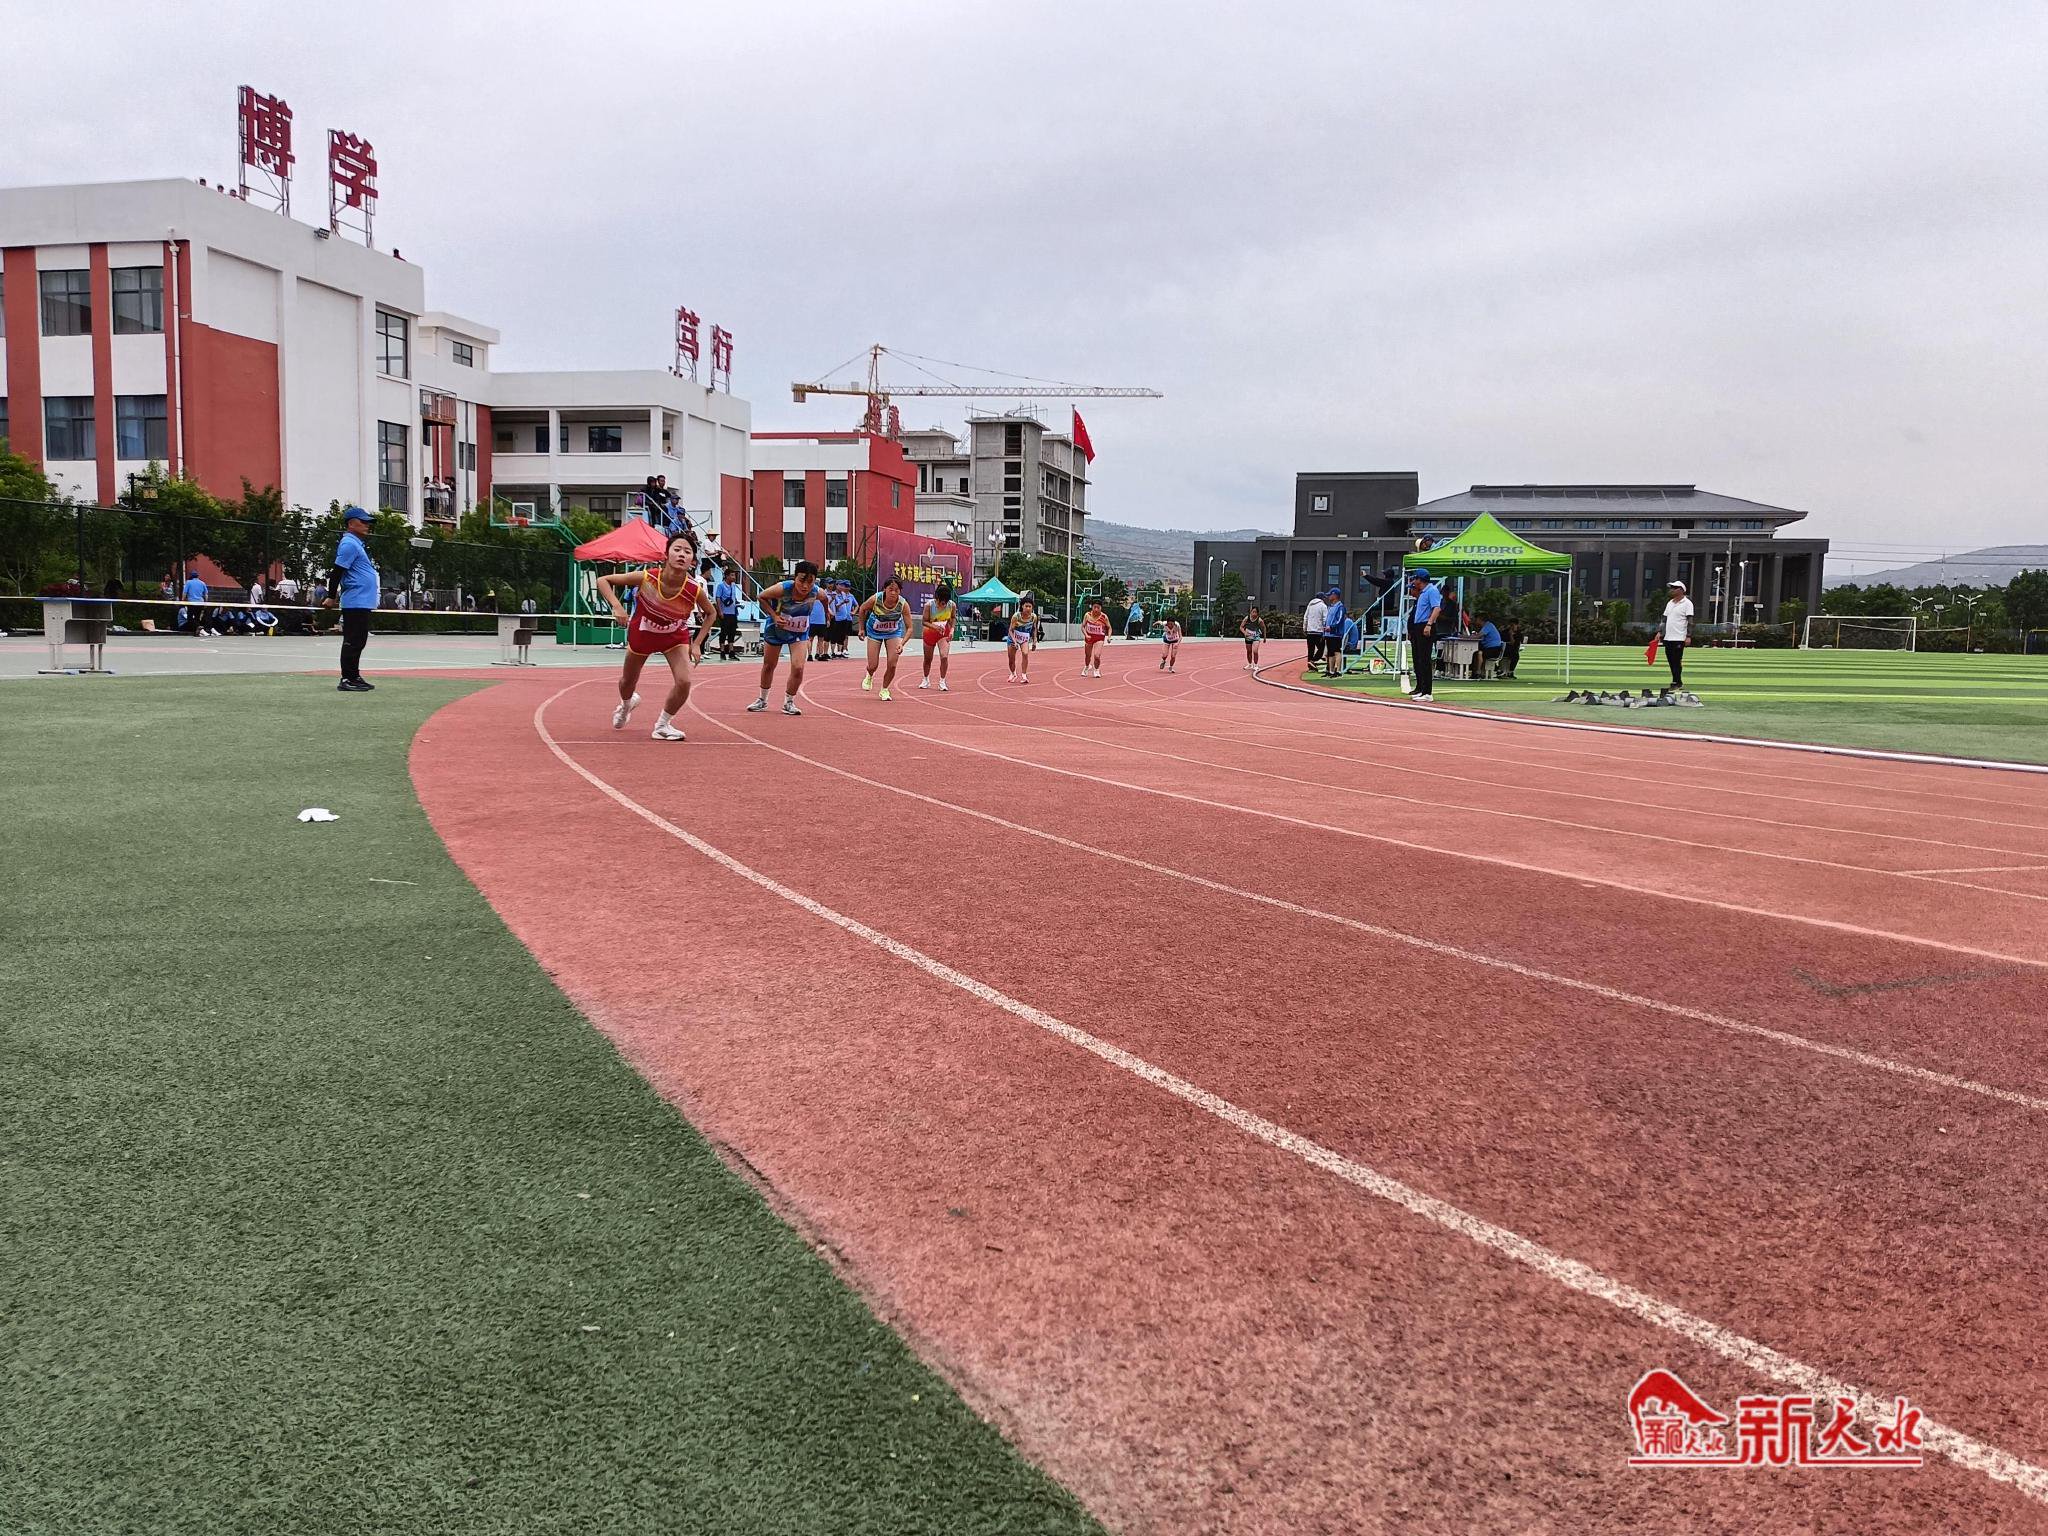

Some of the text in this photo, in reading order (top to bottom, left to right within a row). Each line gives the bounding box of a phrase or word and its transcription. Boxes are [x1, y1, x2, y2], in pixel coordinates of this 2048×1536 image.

[239, 85, 378, 207] 博学
[679, 305, 733, 373] 笃行
[1450, 546, 1523, 554] TUBORG
